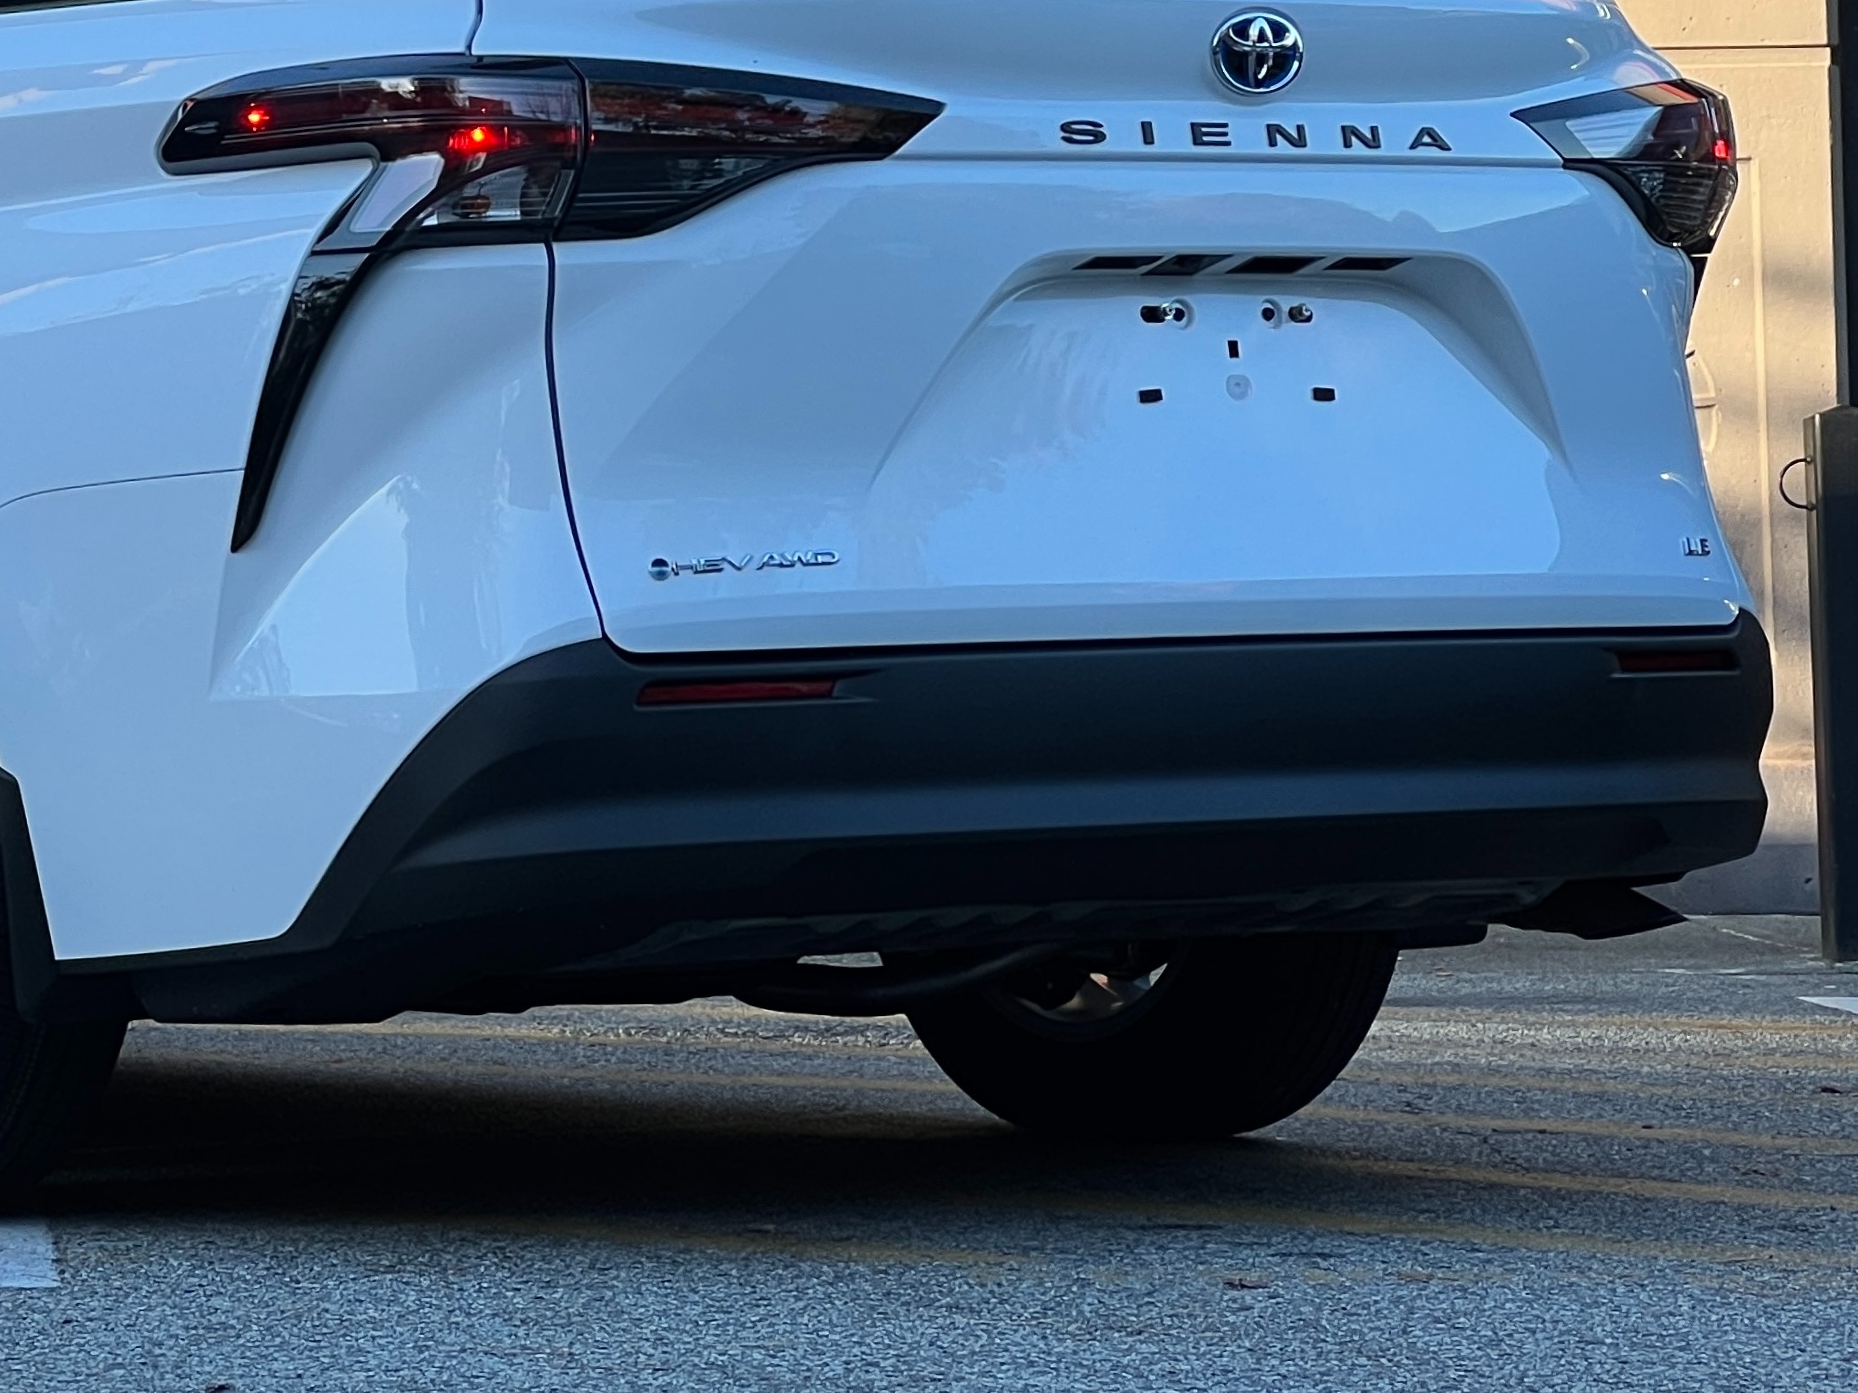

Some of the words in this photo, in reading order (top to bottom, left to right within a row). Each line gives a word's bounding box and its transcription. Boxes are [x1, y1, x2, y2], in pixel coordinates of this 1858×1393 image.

[1059, 119, 1452, 152] SIENNA
[1682, 537, 1711, 557] LE
[756, 549, 840, 571] AWD
